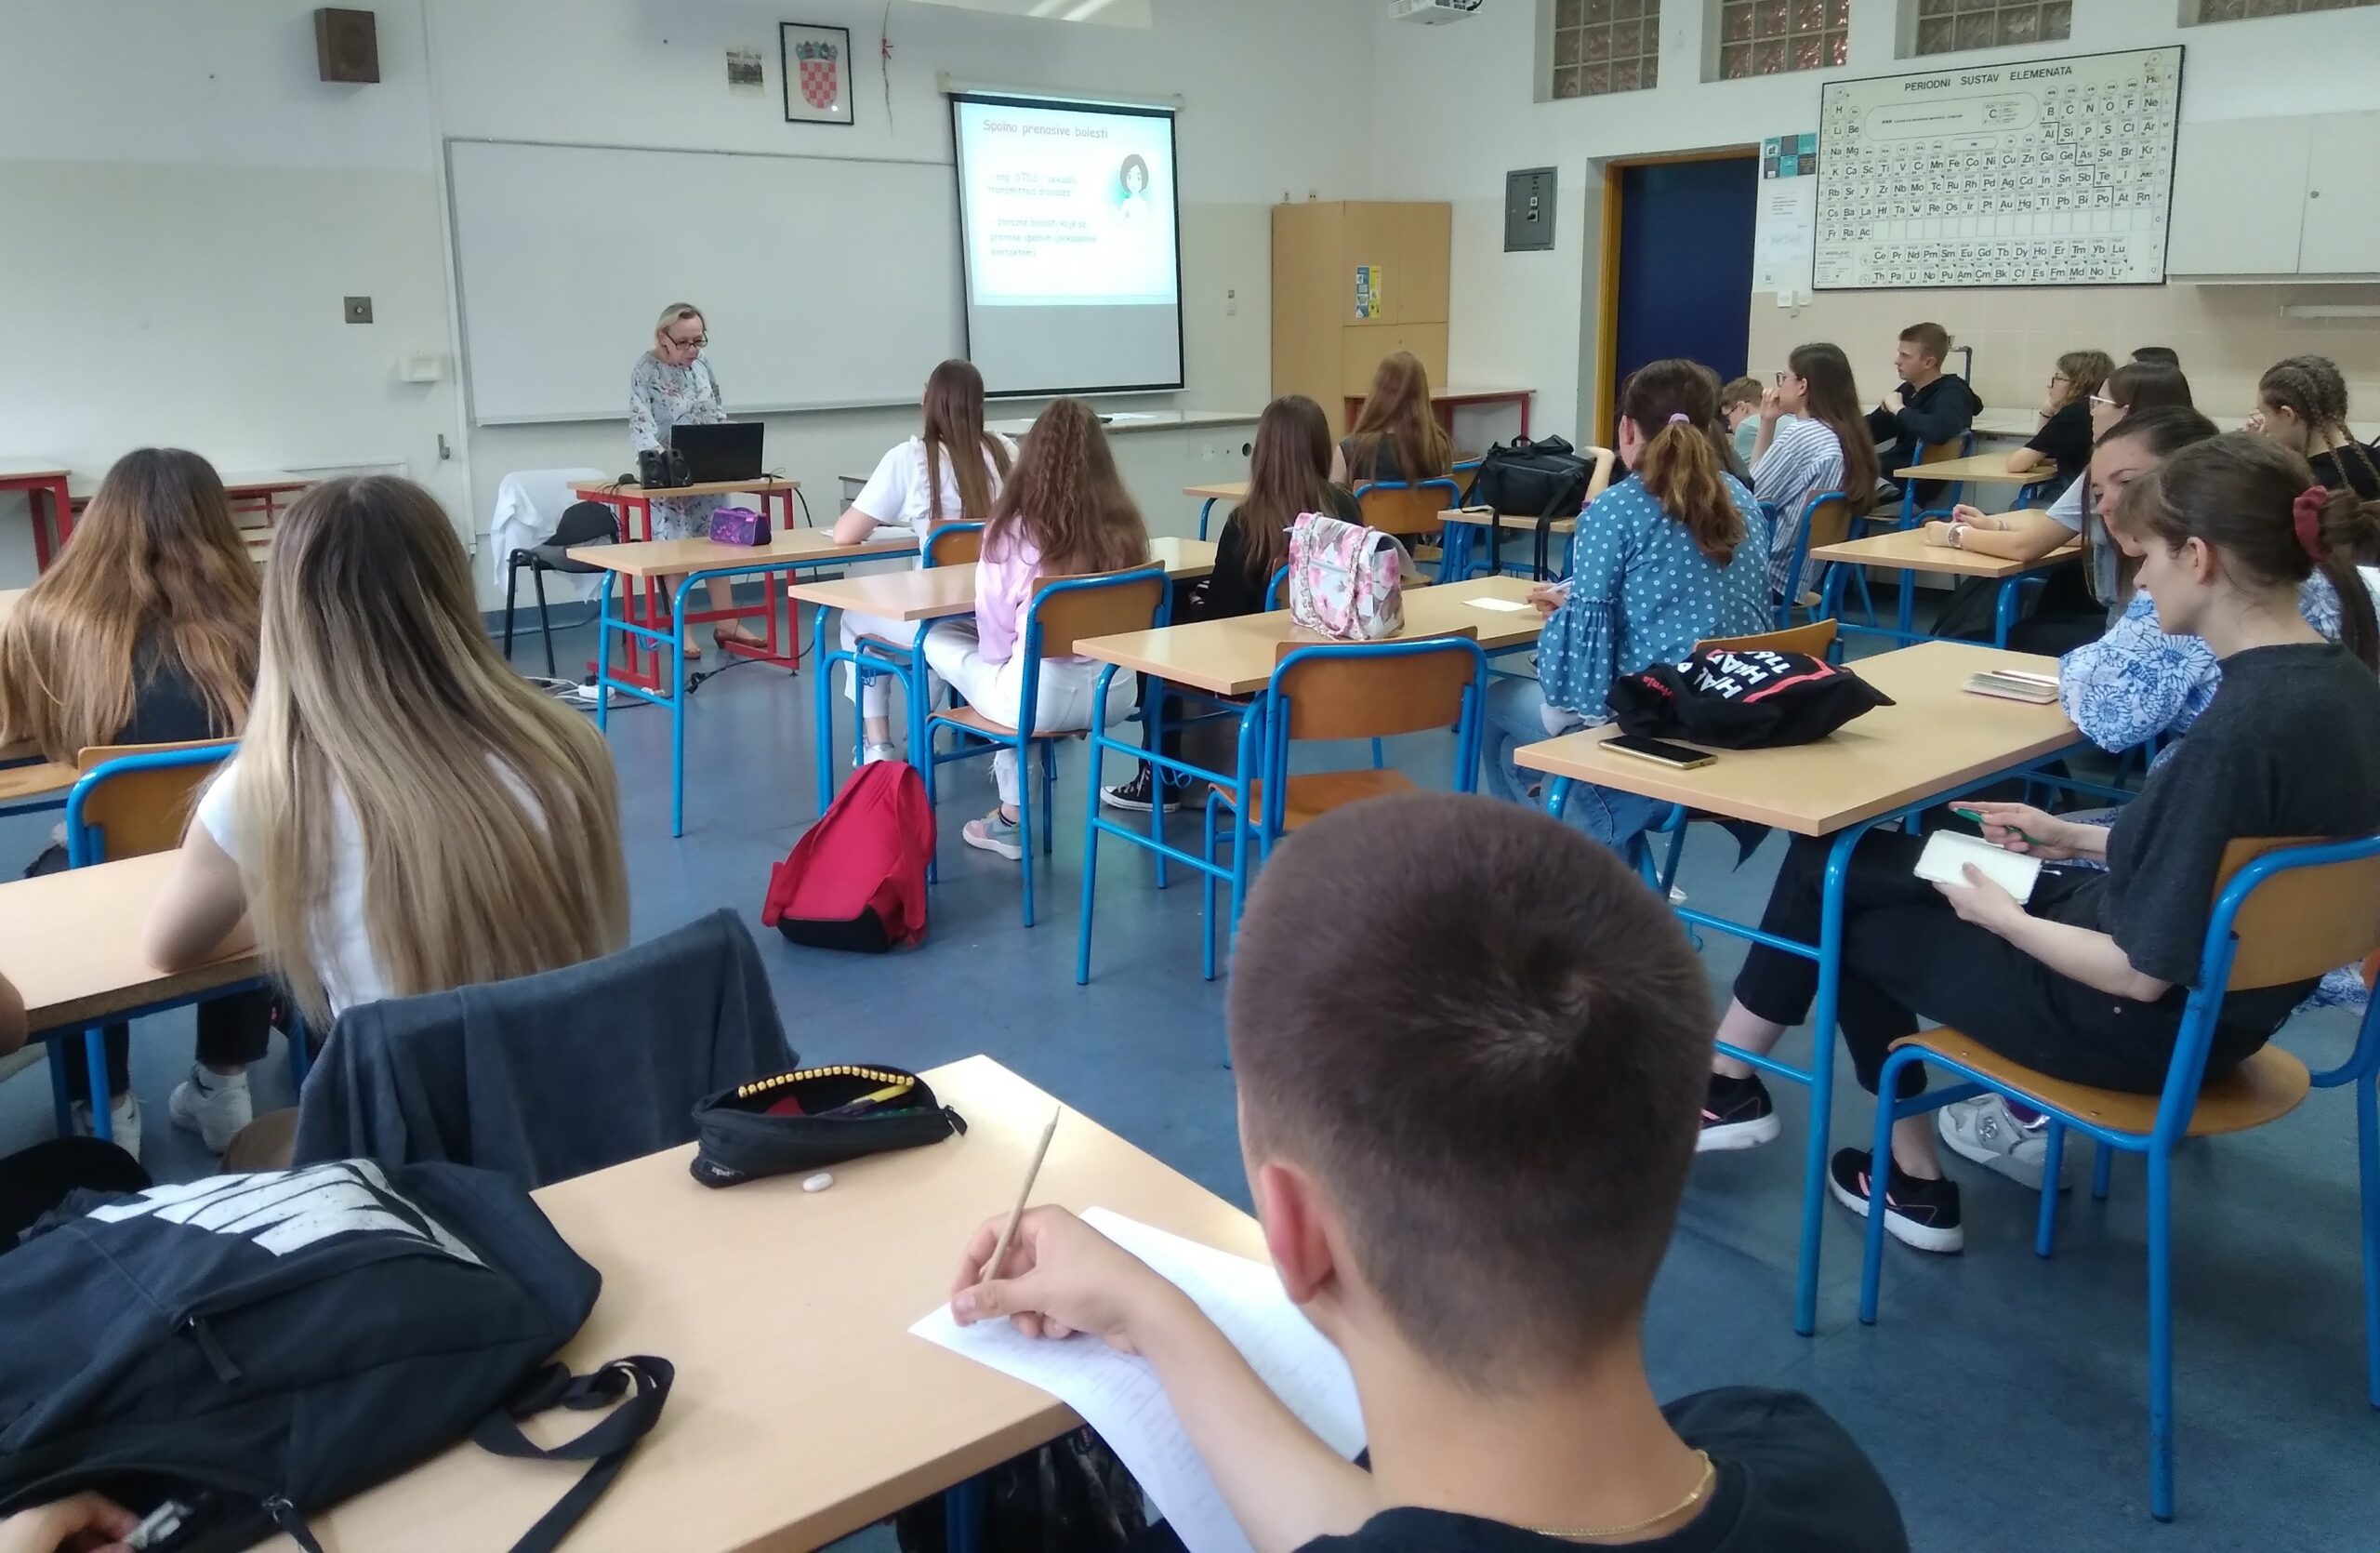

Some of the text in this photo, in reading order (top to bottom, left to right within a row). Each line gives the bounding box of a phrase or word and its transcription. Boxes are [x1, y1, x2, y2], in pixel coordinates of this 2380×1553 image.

[1904, 65, 2072, 92] PERIODNI SUSTAV ELEMENATA
[1835, 105, 1843, 114] H
[2047, 107, 2055, 116] B
[2066, 104, 2074, 114] C
[2086, 104, 2094, 113] N
[2126, 100, 2135, 109] F
[2144, 98, 2159, 108] Ne
[984, 119, 1017, 133] Spolno
[1075, 126, 1108, 139] bolesti
[1833, 126, 1842, 135] Li
[1847, 125, 1860, 134] Be
[2044, 129, 2055, 139] Al
[2063, 127, 2074, 138] Si
[2084, 126, 2092, 136] P
[2104, 125, 2112, 135] S
[2122, 122, 2135, 133] Cl
[2143, 122, 2156, 131] Ar
[1830, 147, 1842, 156] Na
[1845, 146, 1859, 157] Mg
[1832, 168, 1839, 177] K
[1845, 166, 1858, 176] Ca
[1862, 166, 1874, 175] Sc
[1881, 164, 1890, 173] Ti
[1899, 163, 1907, 172] V
[1913, 161, 1924, 170] Cr
[1930, 161, 1944, 170] Mn
[1949, 159, 1961, 168] Fe
[1965, 157, 1979, 166] Co
[1986, 156, 1996, 166] Ni
[2003, 154, 2016, 165] Cu
[2021, 153, 2035, 163] Zn
[2040, 152, 2055, 161] Ga
[2059, 151, 2074, 160] Ge
[2079, 151, 2093, 159] As
[2098, 148, 2113, 158] Se
[2121, 147, 2133, 156] Br
[2141, 145, 2154, 154] Kr
[1828, 189, 1840, 197] Rb
[1844, 187, 1855, 196] Sr
[1878, 185, 1889, 194] Zr
[1894, 184, 1907, 192] Nb
[1911, 183, 1924, 192] Mo
[1931, 182, 1941, 191] Tc
[1947, 181, 1959, 190] Ru
[1964, 179, 1977, 189] Rh
[1983, 179, 1996, 188] Pd
[2002, 178, 2015, 189] Ag
[2019, 176, 2033, 186] Cd
[2058, 174, 2071, 183] Sn
[2078, 172, 2091, 181] Sb
[2098, 171, 2110, 180] Te
[1827, 208, 1839, 218] Cs
[1844, 208, 1855, 217] Ba
[1860, 207, 1871, 216] La
[1877, 206, 1887, 215] Hf
[1895, 206, 1905, 214] Ta
[1911, 205, 1922, 213] W
[1928, 203, 1940, 212] Re
[1946, 203, 1958, 212] Os
[1982, 200, 1992, 209] Pt
[2000, 200, 2014, 208] Au
[2018, 199, 2031, 209] Hg
[2056, 196, 2070, 206] Pb
[2078, 195, 2088, 205] Bi
[2096, 194, 2109, 204] Po
[2118, 193, 2129, 202] At
[2136, 192, 2150, 201] Rn
[1828, 230, 1836, 238] Fr
[1843, 228, 1854, 237] Ra
[1859, 228, 1871, 236] Ac
[1873, 251, 1886, 260] Ce
[1892, 251, 1902, 259] Pr
[1907, 250, 1921, 259] Nd
[1923, 250, 1938, 259] Pm
[1940, 249, 1955, 259] Sm
[1960, 248, 1973, 258] Eu
[1977, 247, 1991, 257] Gd
[1997, 247, 2010, 257] Tb
[2016, 247, 2028, 258] Dy
[2033, 246, 2047, 256] Ho
[2054, 246, 2065, 255] Er
[2072, 246, 2086, 254] Tm
[2093, 245, 2106, 254] Yb
[2112, 244, 2125, 253] Lu
[1873, 272, 1885, 280] Th
[1890, 272, 1902, 280] Pa
[1910, 272, 1917, 280] U
[1923, 272, 1936, 281] Np
[1941, 271, 1953, 279] Pu
[1957, 270, 1972, 279] Am
[1975, 269, 1990, 278] Cm
[1995, 269, 2007, 278] Bk
[2014, 269, 2025, 278] Cf
[2032, 268, 2044, 277] Es
[2050, 268, 2065, 277] Fm
[2069, 268, 2085, 276] Md
[2090, 267, 2104, 276] No
[2111, 266, 2122, 276] Lr
